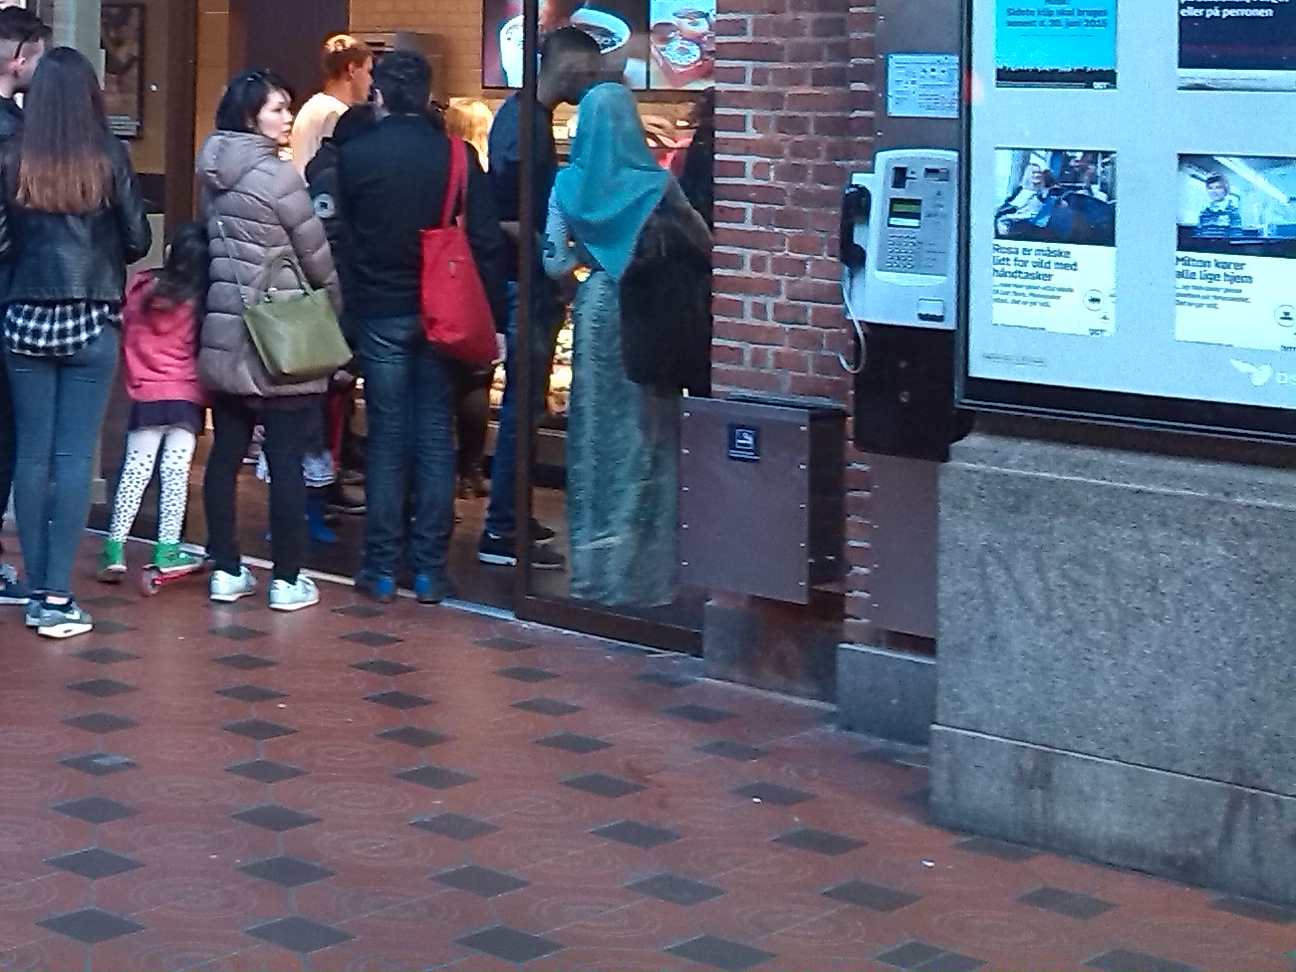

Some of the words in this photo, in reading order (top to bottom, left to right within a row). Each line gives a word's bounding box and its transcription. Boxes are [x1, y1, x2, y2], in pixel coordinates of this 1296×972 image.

[1180, 6, 1204, 17] eller
[1205, 6, 1220, 18] på
[1222, 8, 1274, 19] perronen
[992, 243, 1019, 256] Rosa
[1022, 247, 1033, 256] er
[1034, 247, 1071, 259] måske
[992, 256, 1011, 266] lidt
[1013, 257, 1029, 268] for
[1031, 258, 1051, 269] vild
[1054, 261, 1078, 271] med
[993, 267, 1054, 281] håndtasker
[1175, 269, 1197, 280] alle
[1199, 270, 1222, 283] lige
[1224, 272, 1253, 285] hjem
